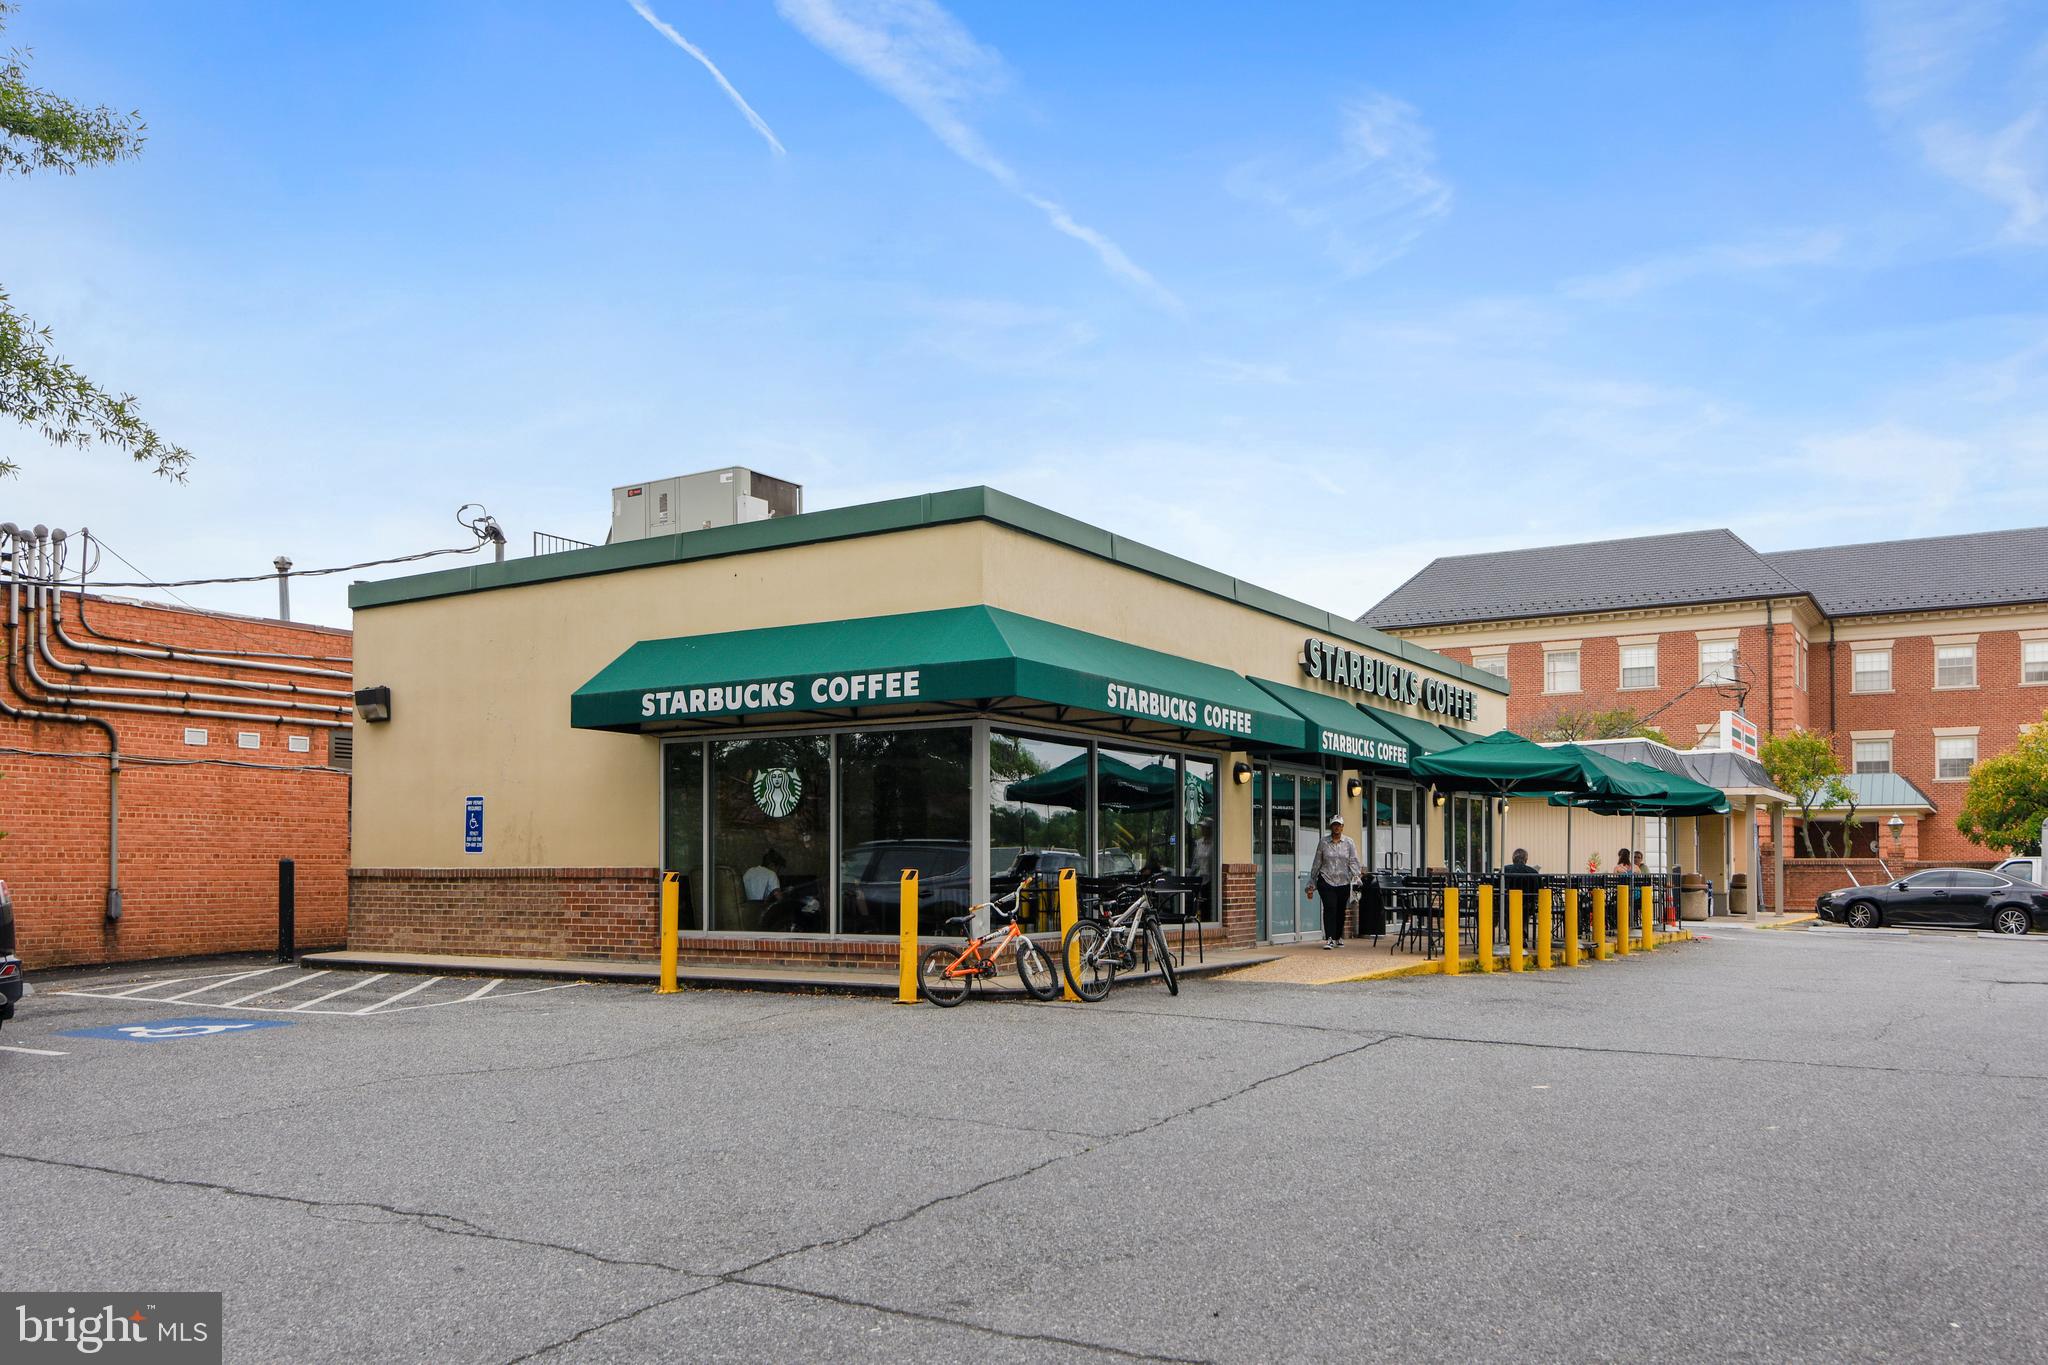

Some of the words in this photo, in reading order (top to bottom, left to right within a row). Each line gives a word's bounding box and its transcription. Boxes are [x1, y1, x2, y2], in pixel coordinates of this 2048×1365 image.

[641, 681, 795, 717] STARBUCKS
[811, 670, 920, 703] COFFEE
[1306, 638, 1420, 706] STARBUCKS
[1423, 677, 1478, 722] COFFEE
[1107, 682, 1197, 724] STARBUCKS
[1203, 704, 1252, 735] COFFEE
[1322, 730, 1375, 759] STARBUCKS
[1377, 742, 1407, 764] COFFEE
